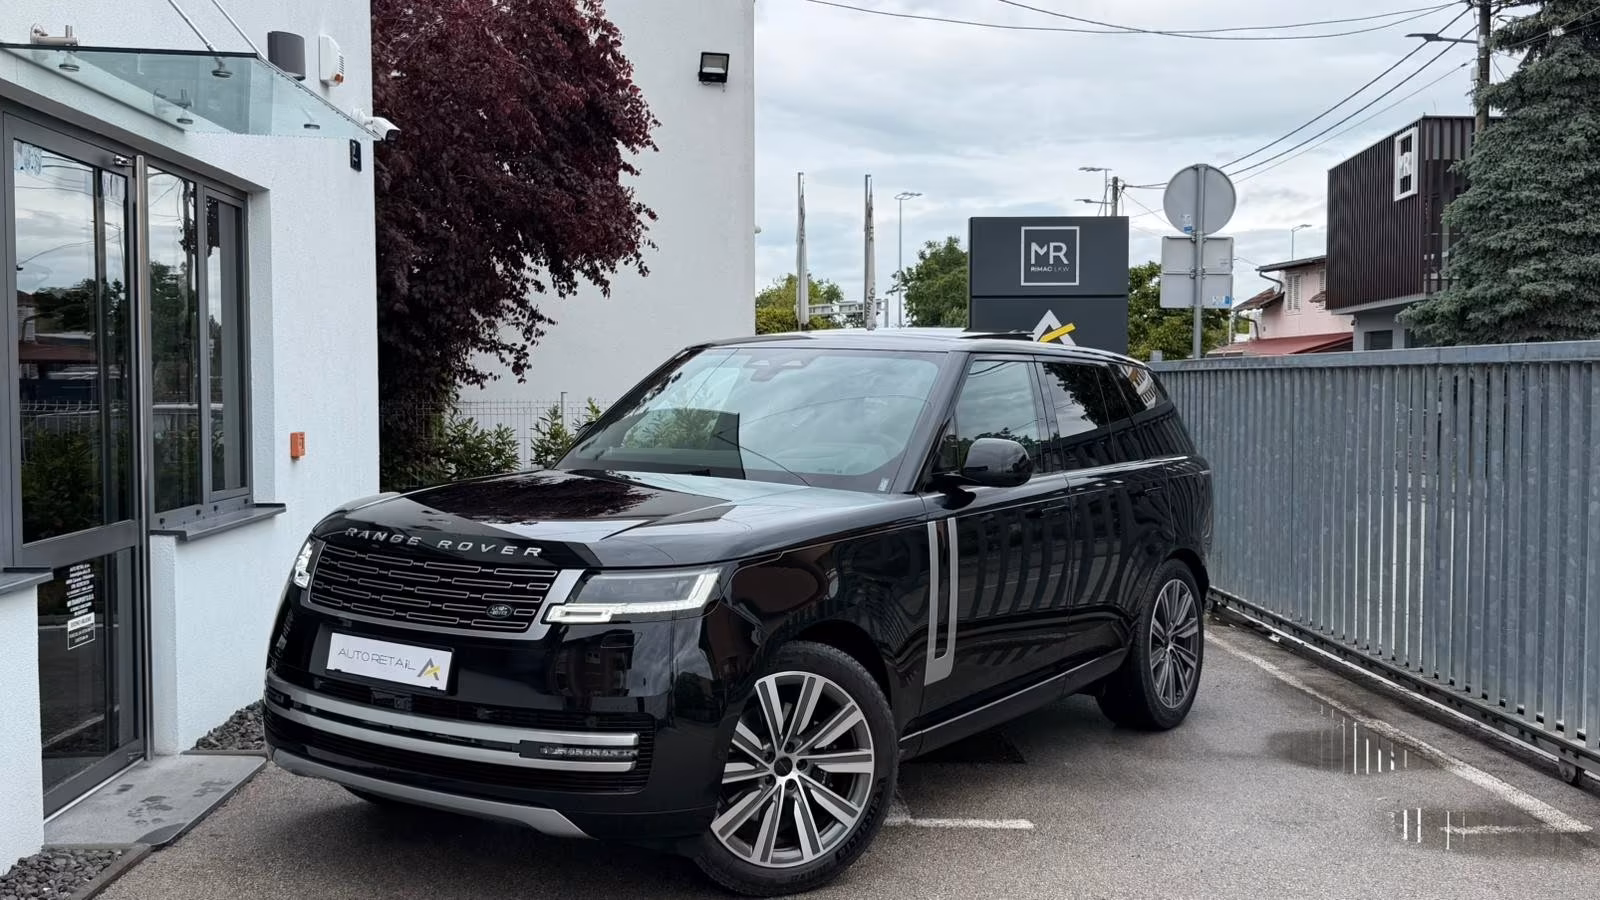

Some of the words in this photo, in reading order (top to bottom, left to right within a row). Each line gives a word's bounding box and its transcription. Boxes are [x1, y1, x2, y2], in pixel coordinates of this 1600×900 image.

[1030, 242, 1070, 265] MR
[344, 527, 422, 546] RANGE
[436, 539, 543, 557] ROVER
